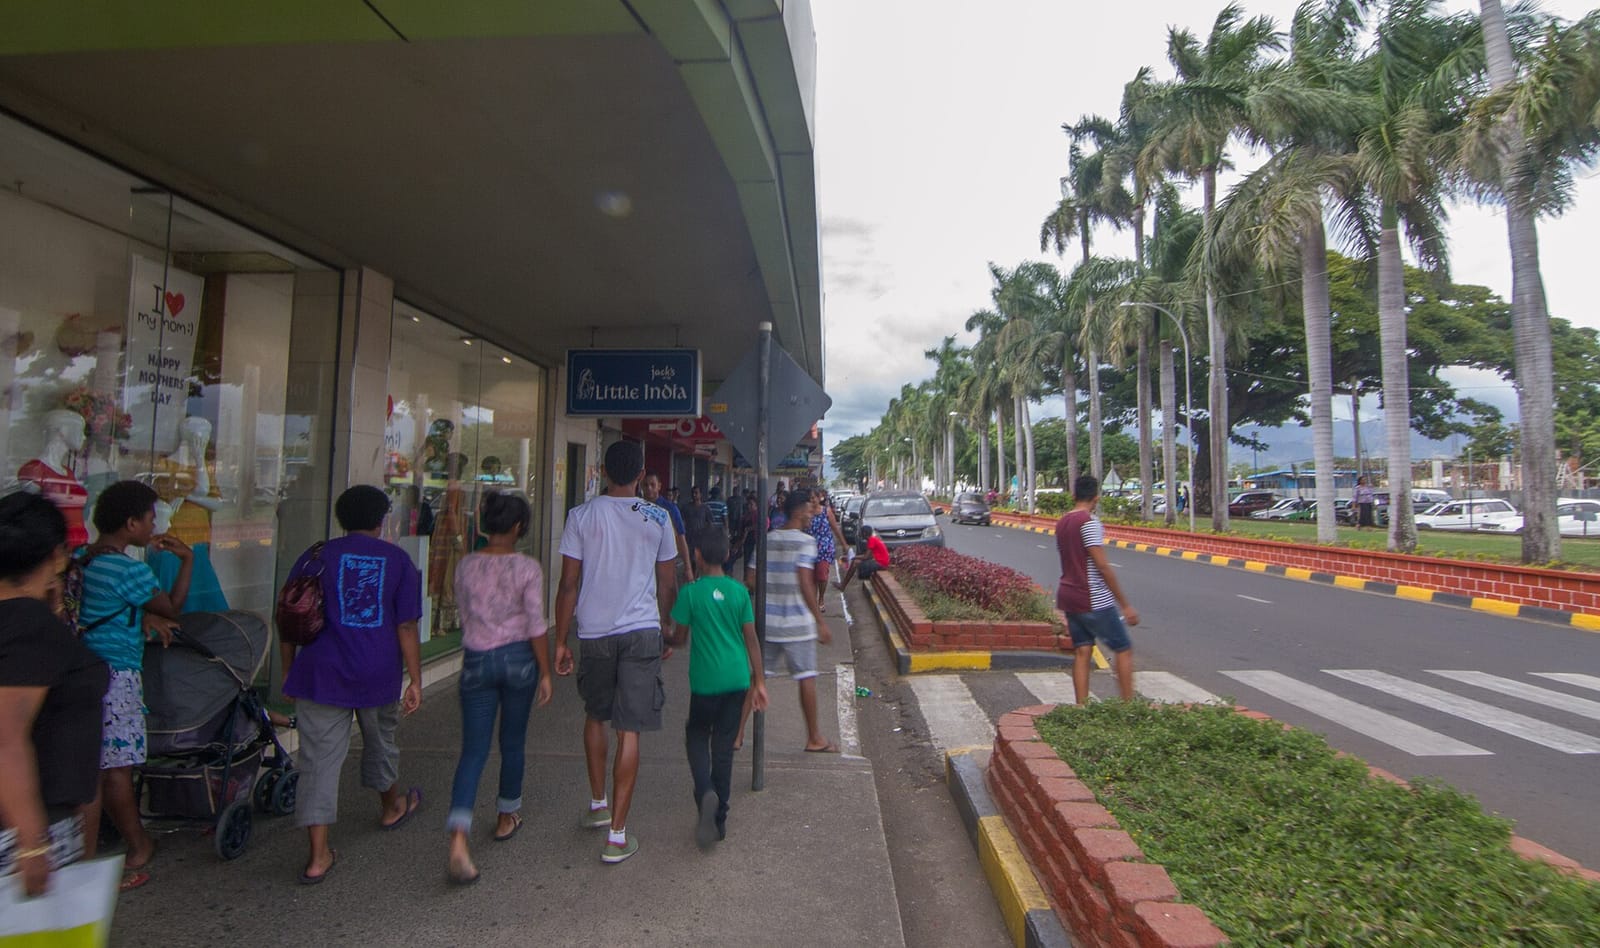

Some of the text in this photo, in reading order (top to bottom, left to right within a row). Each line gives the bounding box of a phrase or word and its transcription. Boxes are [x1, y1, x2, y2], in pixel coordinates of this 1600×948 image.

[153, 284, 162, 315] I
[138, 312, 157, 331] my
[148, 353, 181, 371] HAPPY
[138, 370, 185, 390] MOTHERS
[151, 391, 172, 406] DAY
